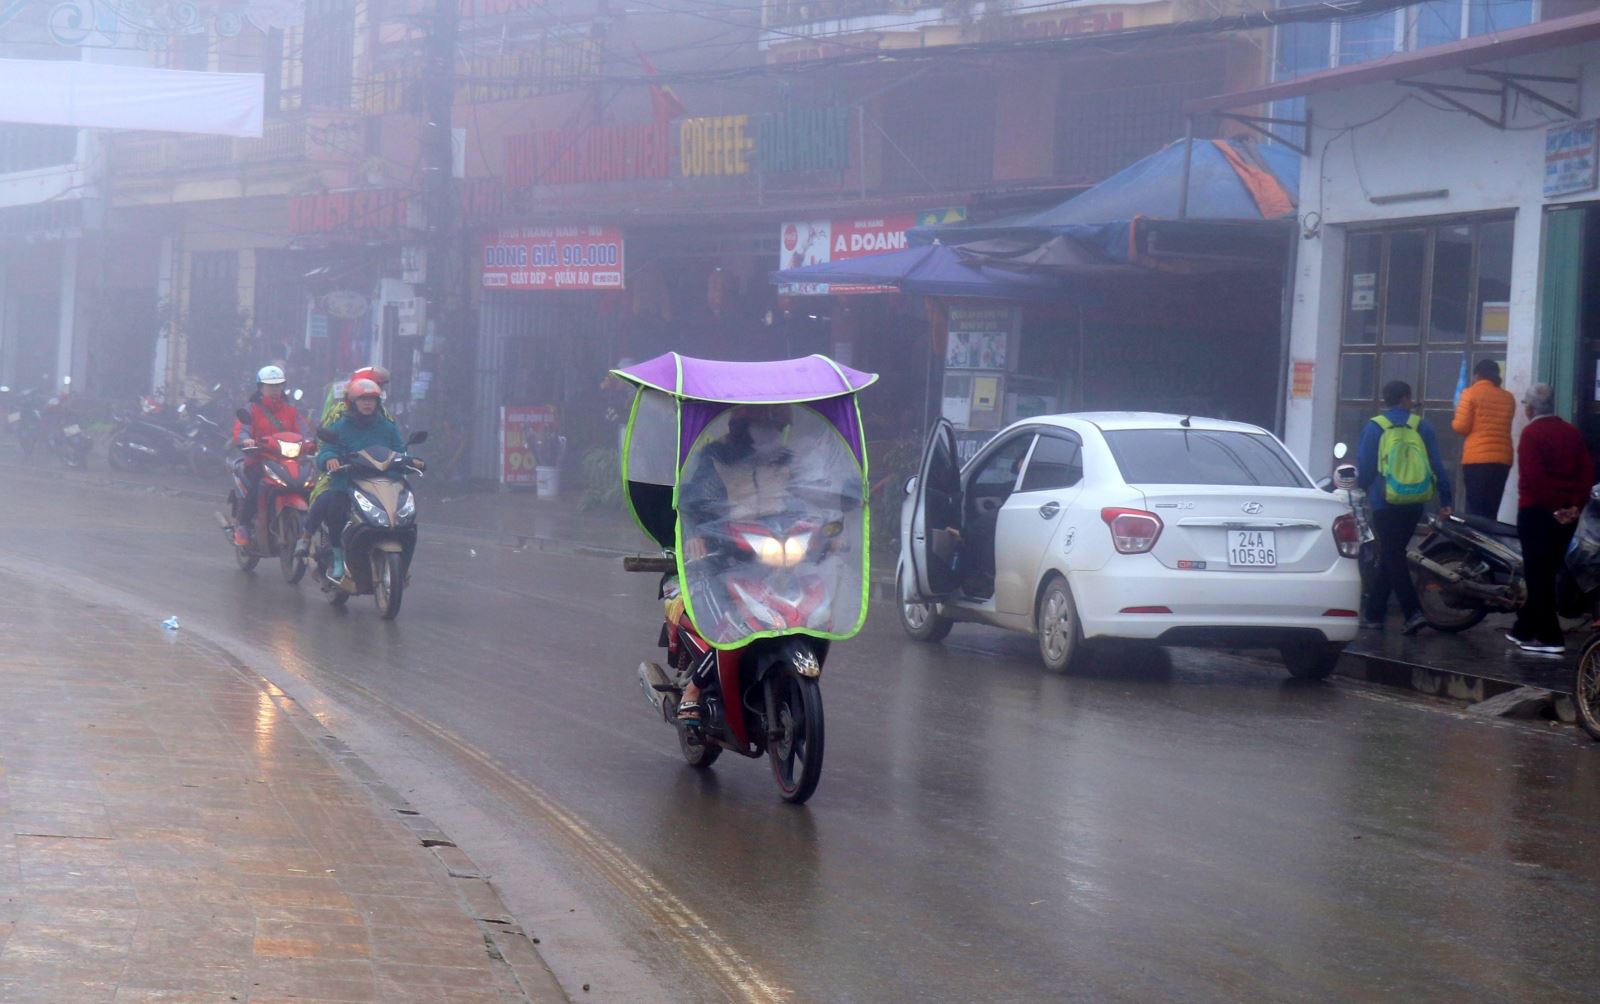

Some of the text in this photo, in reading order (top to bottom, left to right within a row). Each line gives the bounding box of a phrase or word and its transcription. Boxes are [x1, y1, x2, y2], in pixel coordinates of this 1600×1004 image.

[835, 234, 848, 252] A
[562, 242, 618, 267] 90.000
[1239, 532, 1264, 548] 24A
[1232, 548, 1275, 564] 105.96
